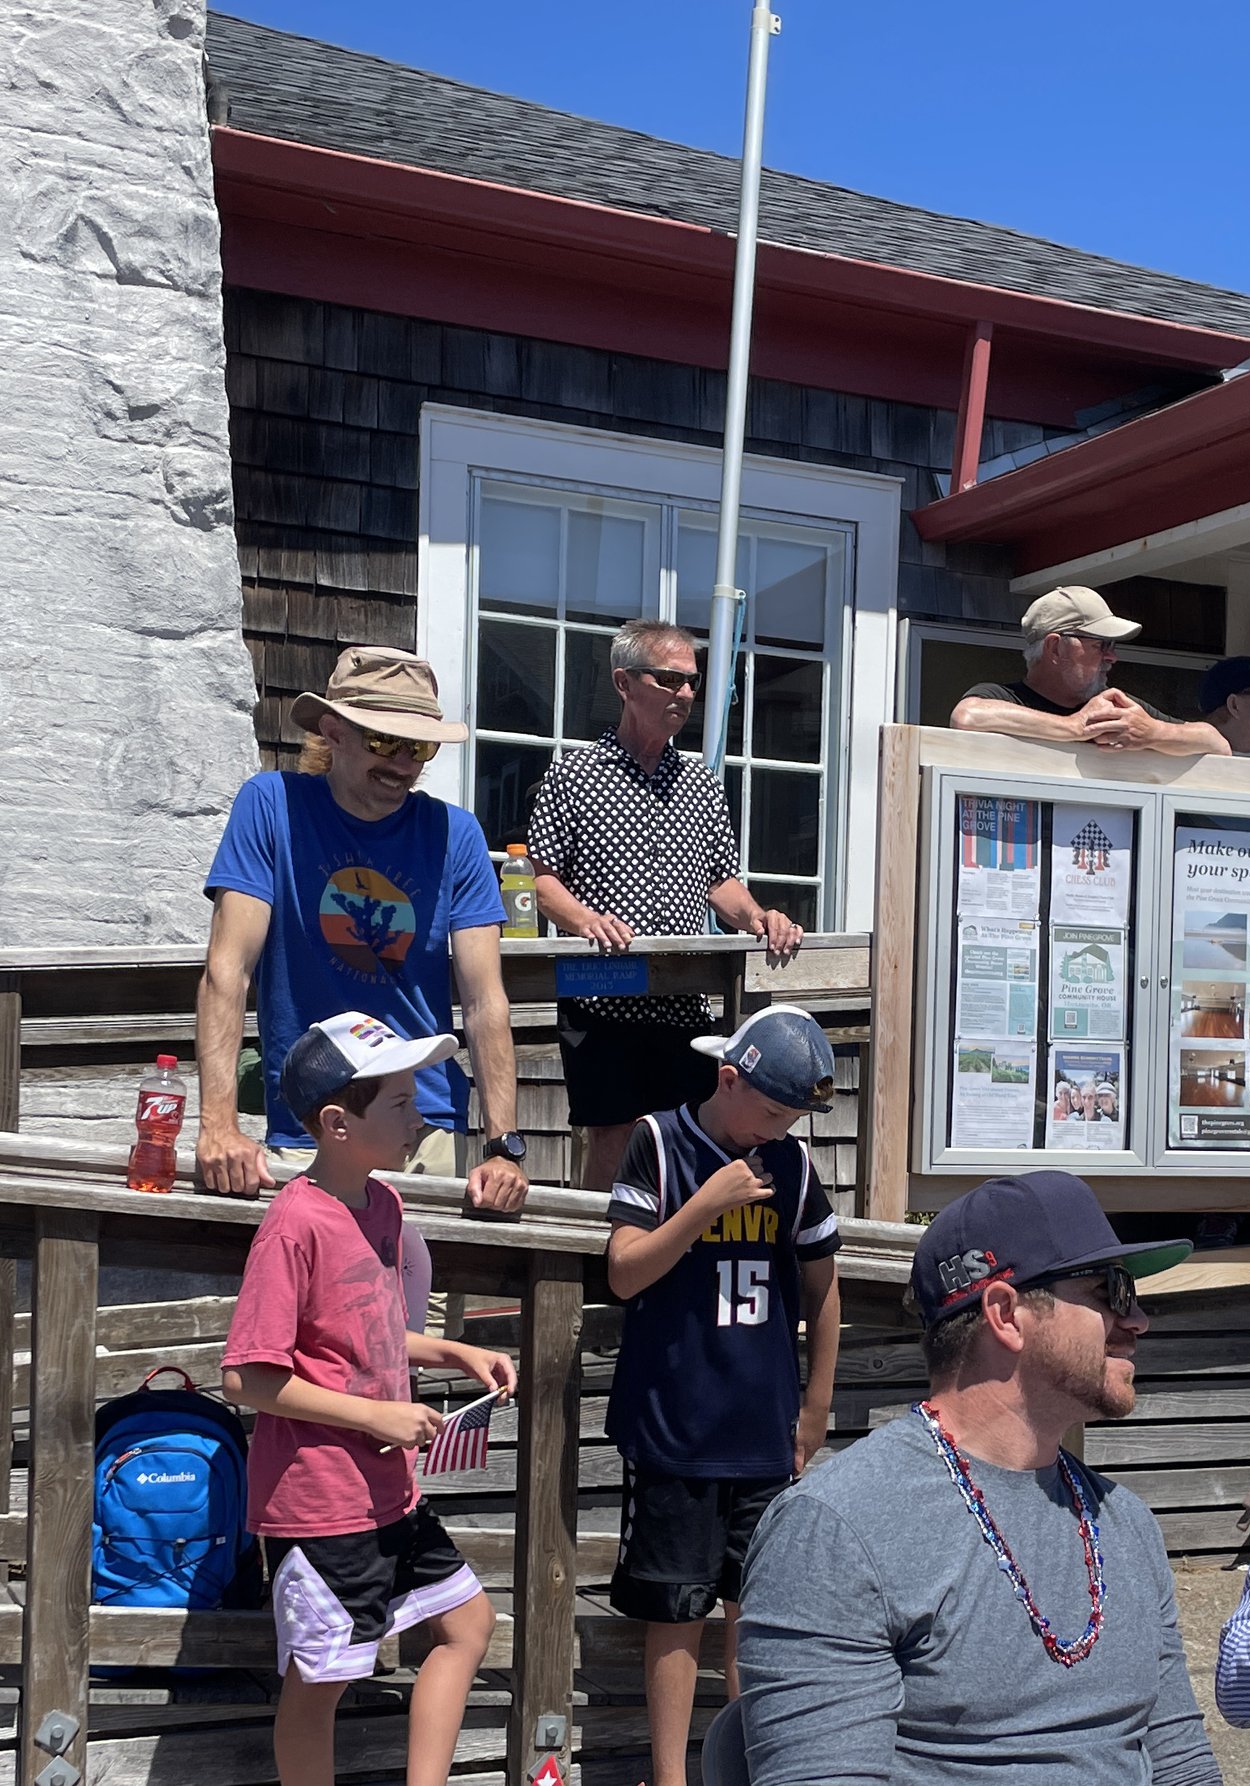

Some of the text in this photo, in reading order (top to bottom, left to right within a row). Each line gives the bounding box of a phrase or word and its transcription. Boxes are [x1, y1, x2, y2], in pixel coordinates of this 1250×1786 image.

[963, 799, 1026, 812] TRIVIA NIGHT
[962, 810, 1020, 823] AT THE PINE
[962, 820, 996, 831] GROVE
[1187, 840, 1234, 856] Make
[1187, 863, 1229, 879] your
[1065, 874, 1116, 888] CHESS CLUB
[514, 892, 532, 912] G
[1063, 932, 1078, 940] JOIN
[1061, 983, 1115, 995] Pine Grove
[717, 1260, 770, 1327] 15
[148, 1471, 196, 1484] Columbia
